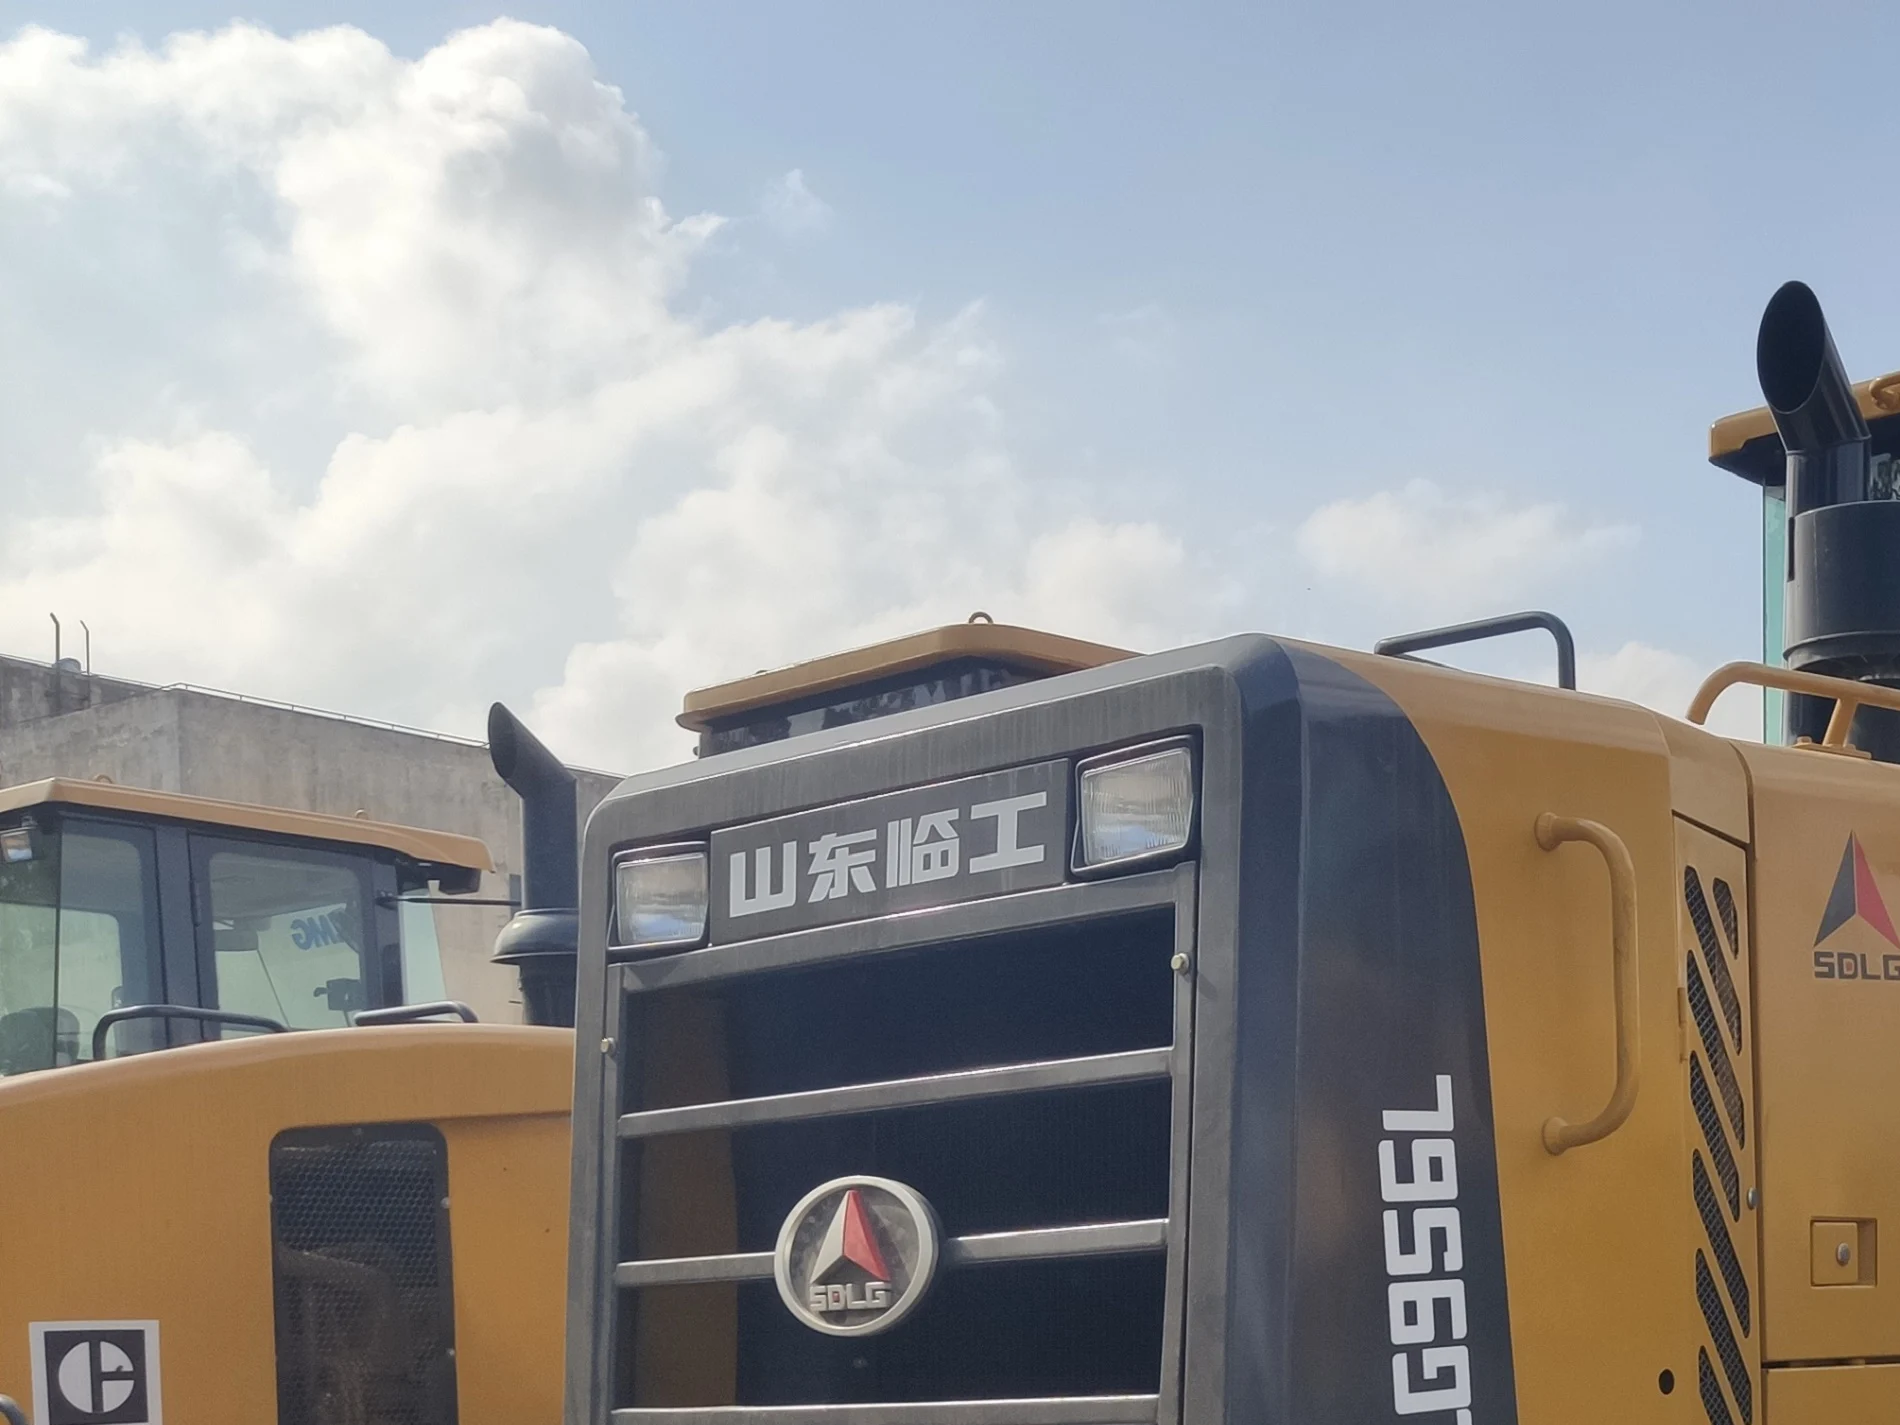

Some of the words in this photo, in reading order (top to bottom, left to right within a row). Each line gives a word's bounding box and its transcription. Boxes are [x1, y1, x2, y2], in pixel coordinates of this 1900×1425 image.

[729, 791, 1047, 918] 山东临工
[810, 1281, 892, 1312] SDLG
